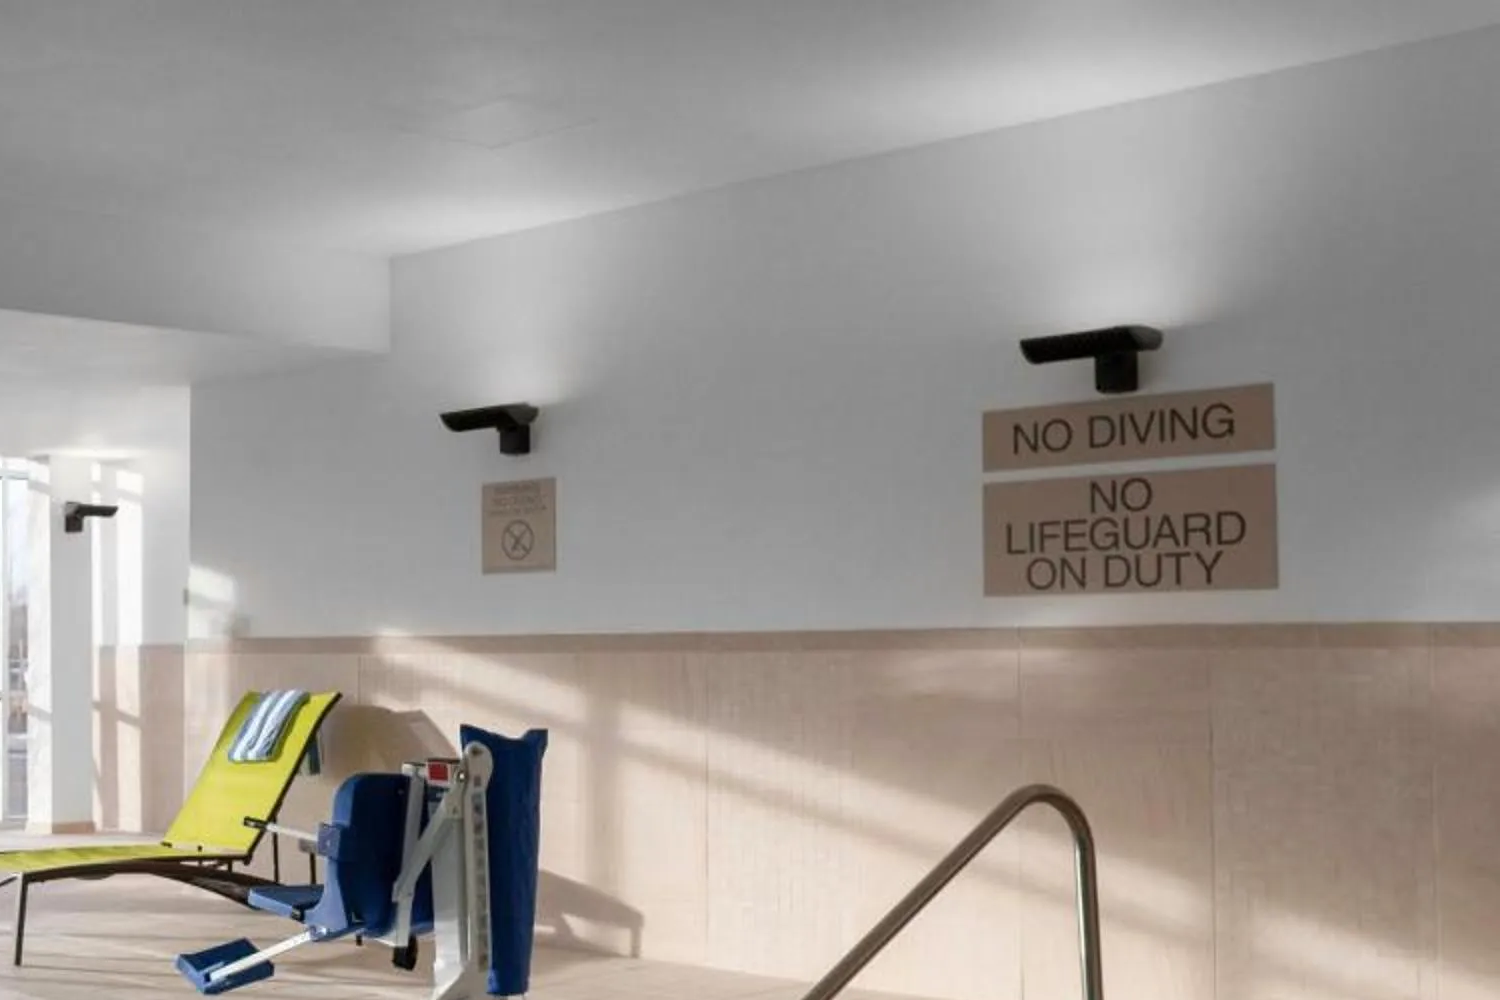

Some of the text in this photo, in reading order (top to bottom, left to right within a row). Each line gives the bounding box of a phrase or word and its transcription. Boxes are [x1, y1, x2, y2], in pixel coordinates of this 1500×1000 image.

[1012, 402, 1236, 455] NO DIVING
[1089, 477, 1153, 514] NO
[1005, 511, 1247, 555] LIFEGUARD
[1026, 550, 1224, 590] ON DUTY
